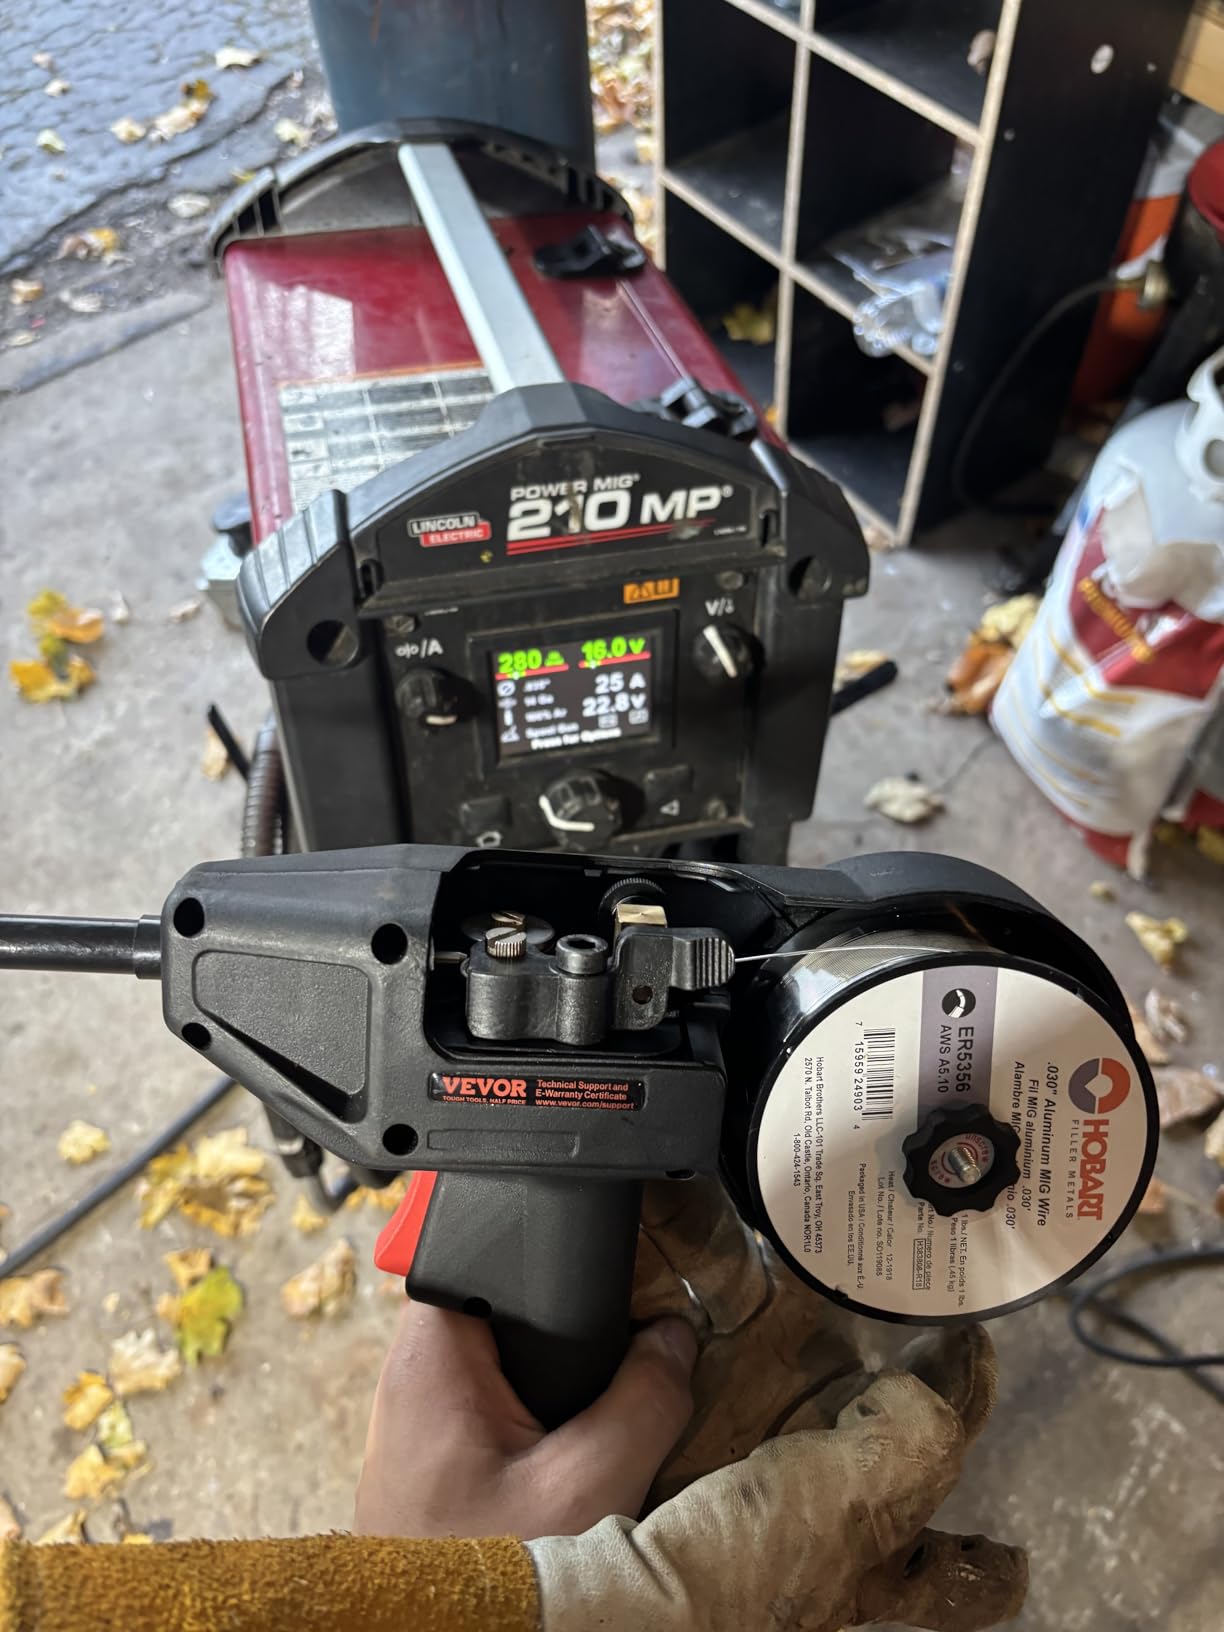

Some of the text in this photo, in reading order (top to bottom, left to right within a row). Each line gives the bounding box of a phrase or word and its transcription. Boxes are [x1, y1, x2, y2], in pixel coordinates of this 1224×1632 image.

[510, 480, 588, 501] POWER
[412, 516, 475, 533] LINCOLN
[507, 489, 631, 541] 210
[429, 528, 485, 543] ELECTRIC
[582, 636, 627, 660] 16.0
[498, 649, 542, 673] 280
[595, 672, 646, 694] 25 A
[582, 691, 629, 717] 22.8
[803, 1057, 813, 1076] 2570
[937, 1024, 952, 1093] AWS A5.10
[955, 1026, 974, 1092] ER5356
[537, 1080, 629, 1092] Technical Support and
[803, 1076, 813, 1085] N.
[853, 1041, 864, 1111] 15959 24903
[1012, 1061, 1025, 1109] Alambre
[1028, 1079, 1040, 1094] Fil
[442, 1077, 526, 1098] VEVOR
[535, 1089, 627, 1100] E-Warranty Certificate
[803, 1087, 813, 1109] Talbot
[535, 1099, 634, 1110] www.vevor.com/support
[1026, 1096, 1038, 1118] MIG
[803, 1125, 813, 1138] Old
[802, 1139, 813, 1165] Castle,
[1022, 1121, 1036, 1179] aluminium
[1037, 1061, 1059, 1227] .030" Aluminum MIG Wire
[812, 1056, 825, 1254] Hobart Brothers LLC-101 Trade Sq. East Troy, OH 45373
[802, 1165, 812, 1195] Ontario,
[856, 1163, 867, 1194] Packaged
[887, 1170, 896, 1188] Heat
[1065, 1120, 1080, 1219] FILLER METALS
[1077, 1119, 1110, 1221] HOBART
[877, 1176, 886, 1189] Lot
[847, 1190, 856, 1222] Envasado
[877, 1190, 885, 1204] No.
[886, 1193, 895, 1222] Chaleur
[802, 1195, 812, 1223] Canada
[857, 1203, 866, 1218] USA
[876, 1209, 884, 1226] Lote
[918, 1201, 926, 1221] Parte
[847, 1223, 853, 1232] en
[950, 1217, 958, 1236] Peso
[847, 1232, 855, 1243] los
[886, 1227, 894, 1248] Calor
[949, 1243, 957, 1264] libras
[959, 1255, 966, 1265] En
[926, 1260, 934, 1269] de
[947, 1280, 956, 1292] kg)
[958, 1266, 966, 1287] poids
